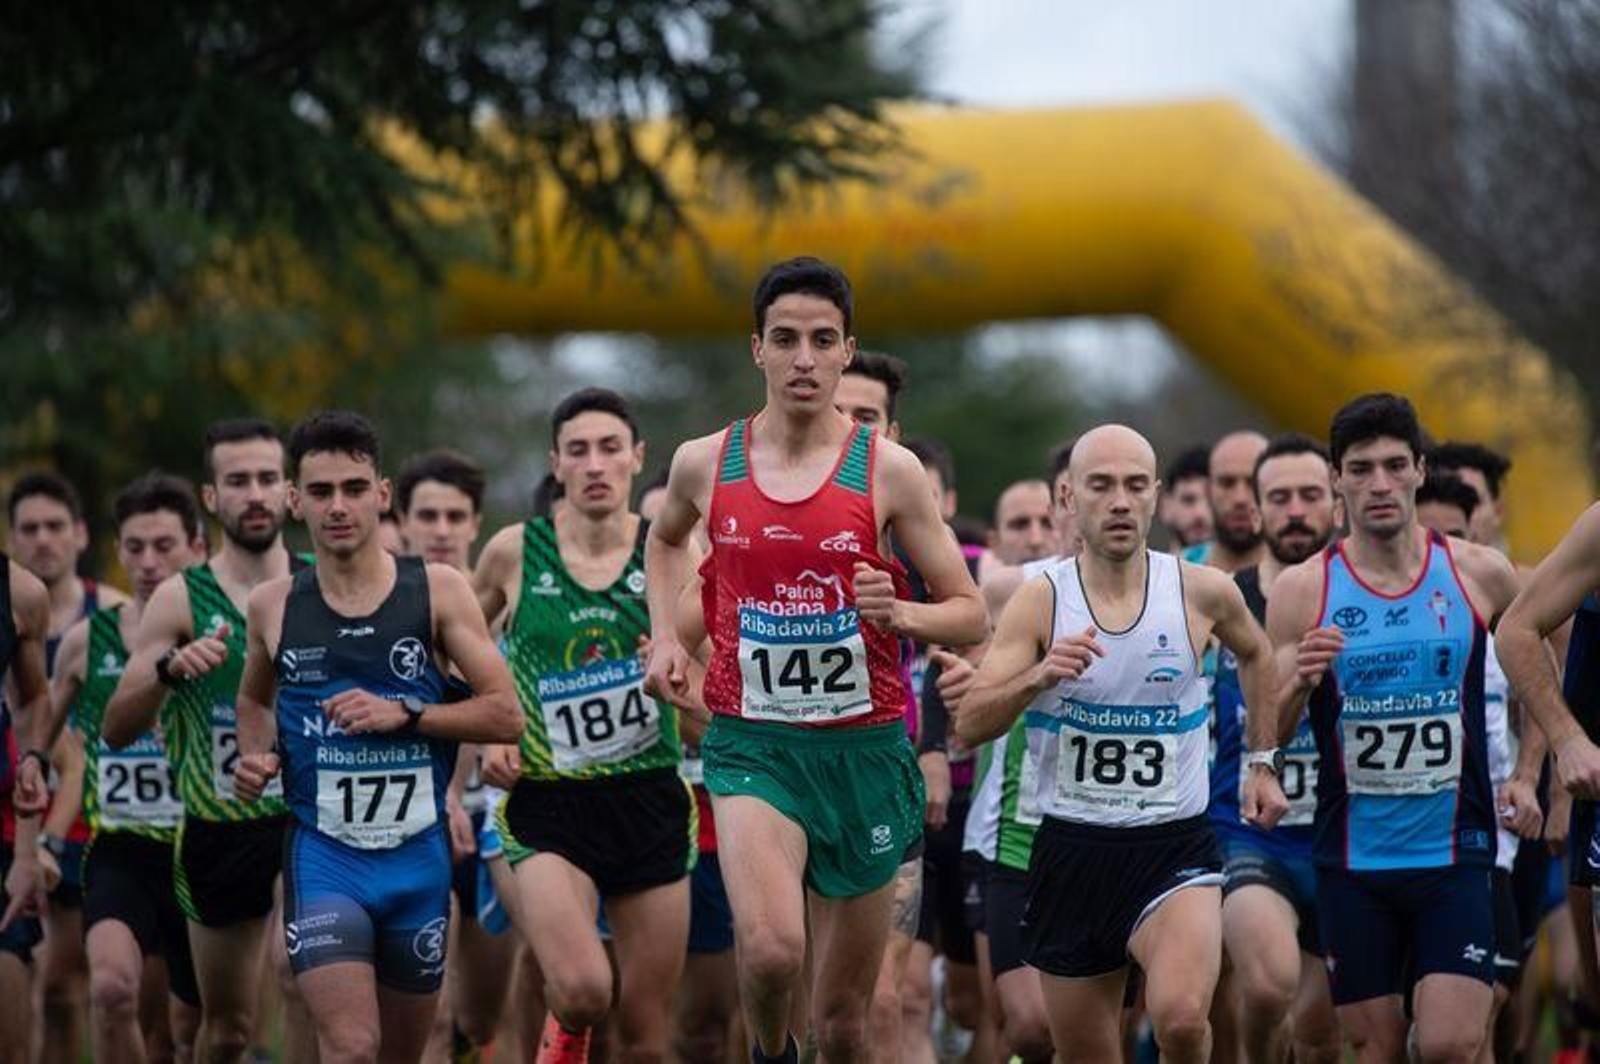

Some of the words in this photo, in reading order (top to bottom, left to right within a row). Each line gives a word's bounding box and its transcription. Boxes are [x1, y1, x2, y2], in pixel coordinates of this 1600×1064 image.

[774, 583, 824, 599] Patria
[741, 612, 834, 637] Ribadavia
[837, 611, 857, 632] 22
[751, 647, 857, 695] 142
[1347, 649, 1417, 668] CONCELLO
[540, 664, 625, 696] Ribadavia
[1063, 702, 1151, 727] Ribadavia
[1155, 709, 1177, 727] 22
[1343, 693, 1433, 713] Ribadavia
[1437, 689, 1458, 707] 22
[555, 687, 650, 748] 184
[316, 746, 407, 764] Ribadavia
[411, 743, 431, 760] 22
[1356, 720, 1452, 770] 279
[1071, 735, 1165, 787] 183
[336, 774, 417, 823] 177
